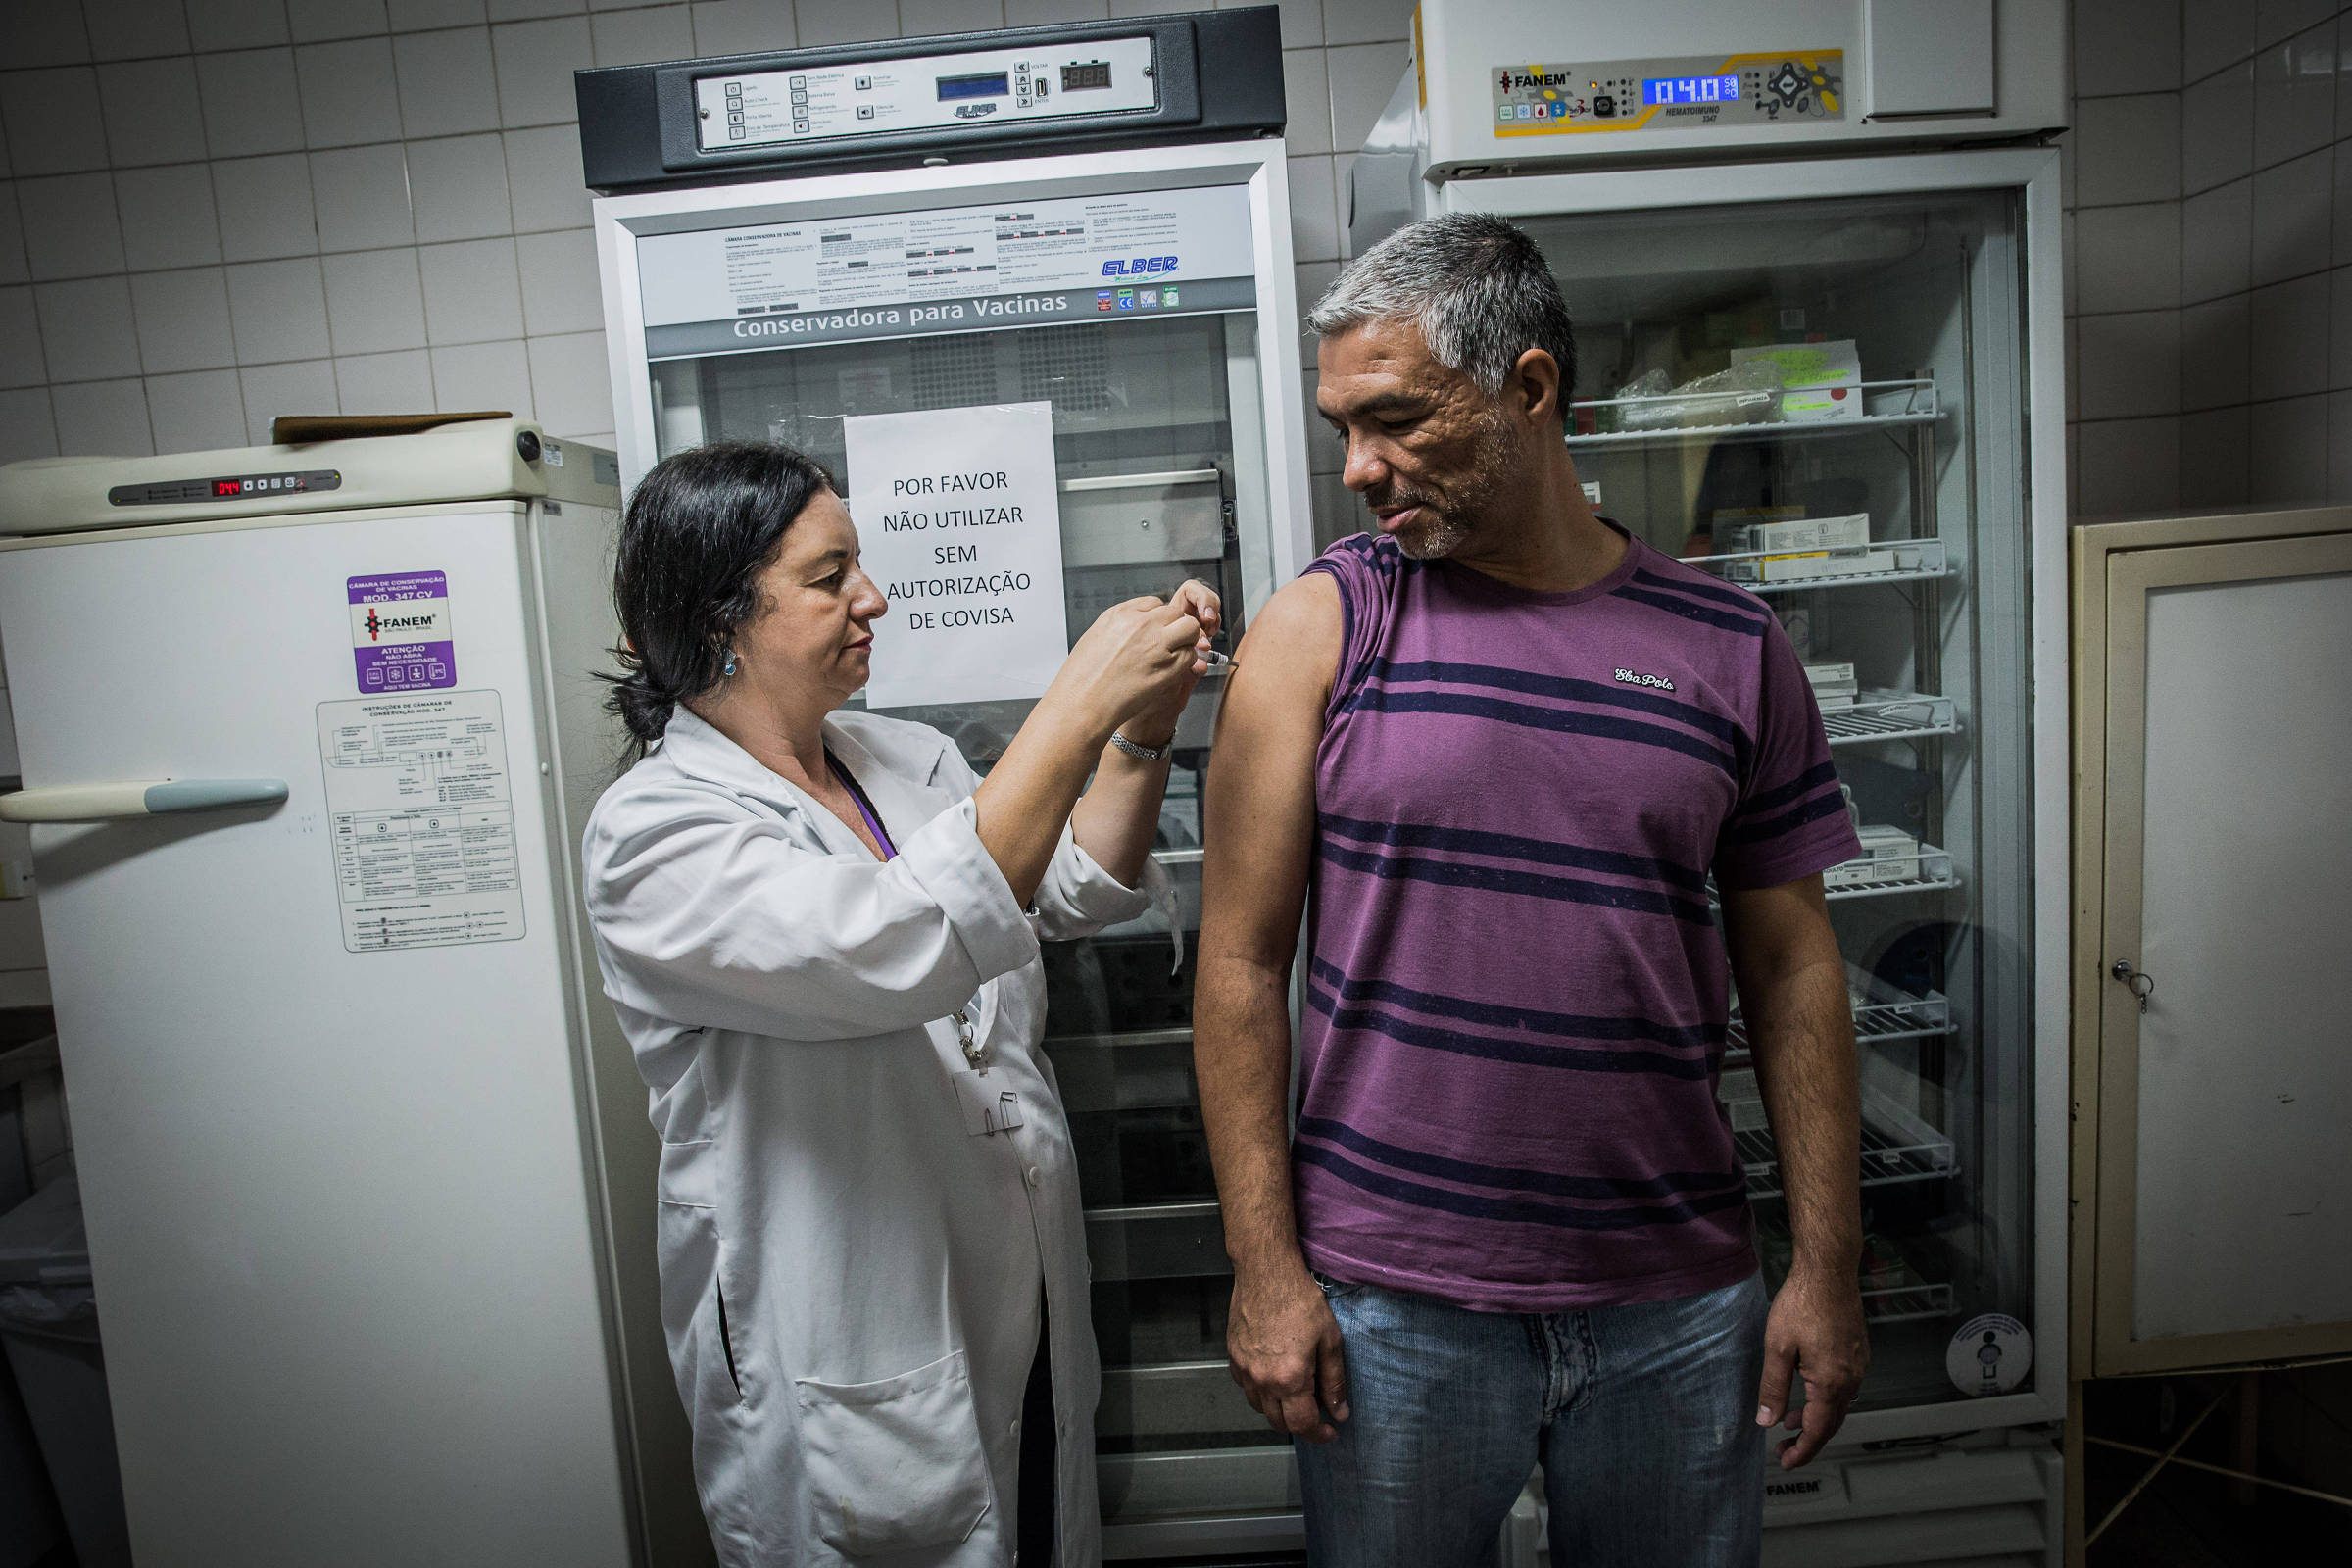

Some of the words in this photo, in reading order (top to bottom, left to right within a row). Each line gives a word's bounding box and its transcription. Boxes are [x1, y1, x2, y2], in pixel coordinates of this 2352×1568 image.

[1515, 74, 1566, 87] FANEM
[1102, 256, 1178, 276] ELBER
[734, 306, 901, 338] Conservadora
[908, 301, 964, 326] para
[973, 294, 1068, 317] Vacinas
[893, 476, 934, 497] POR
[940, 470, 1008, 493] FAVOR
[883, 510, 928, 532] NÃO
[935, 506, 1023, 529] UTILIZAR
[934, 545, 977, 564] SEM
[391, 576, 445, 586] CONSERVAÇÃO
[887, 570, 1031, 600] AUTORIZAÇÃO
[363, 593, 392, 603] MOD.
[395, 591, 415, 601] 347
[416, 590, 433, 599] CV
[383, 615, 432, 628] FANEM
[909, 612, 935, 630] DE
[941, 606, 1015, 628] COVISA
[381, 645, 425, 655] ATENÇÃO
[388, 657, 438, 665] NECESSIDADE
[1642, 674, 1674, 690] Polo
[369, 709, 415, 717] CONSERVAÇÃO
[1766, 1481, 1820, 1496] FANEM
